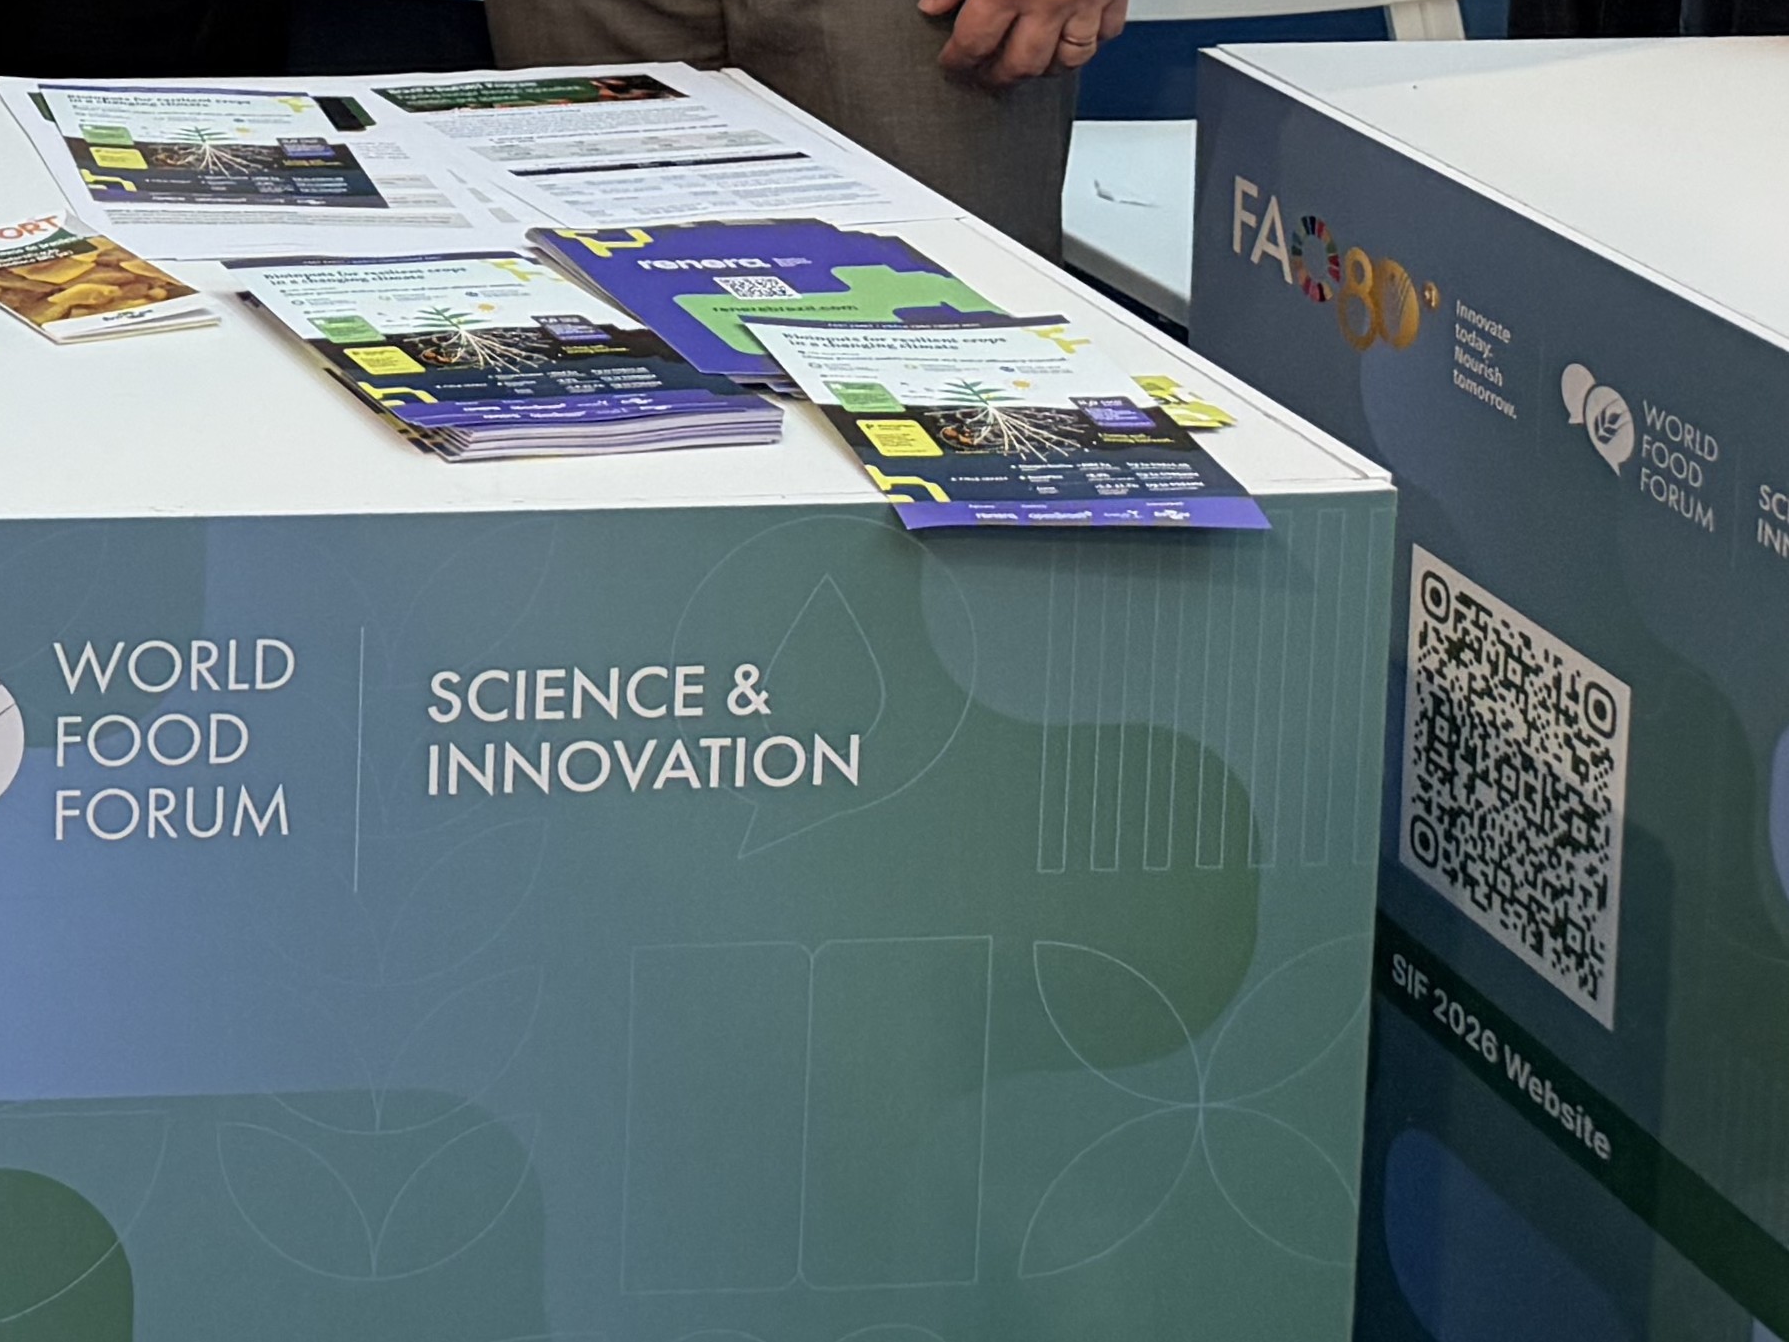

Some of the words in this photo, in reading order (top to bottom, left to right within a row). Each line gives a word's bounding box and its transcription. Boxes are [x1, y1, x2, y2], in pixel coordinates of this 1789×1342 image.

[637, 256, 771, 273] renera
[1454, 323, 1494, 360] today.
[1455, 298, 1511, 344] Innovate
[1452, 368, 1517, 420] tomorrow.
[1454, 347, 1504, 387] Nourish
[1642, 399, 1719, 461] WORLD
[1642, 434, 1703, 488] FOOD
[1640, 467, 1714, 532] FORUM
[53, 640, 296, 695] WORLD
[428, 664, 706, 724] SCIENCE
[726, 664, 772, 715] &
[56, 715, 249, 768] FOOD
[427, 735, 860, 796] INNOVATION
[56, 786, 290, 841] FORUM
[1391, 951, 1429, 1001] SIF
[1432, 986, 1500, 1065] 2026
[1504, 1044, 1612, 1161] Website
